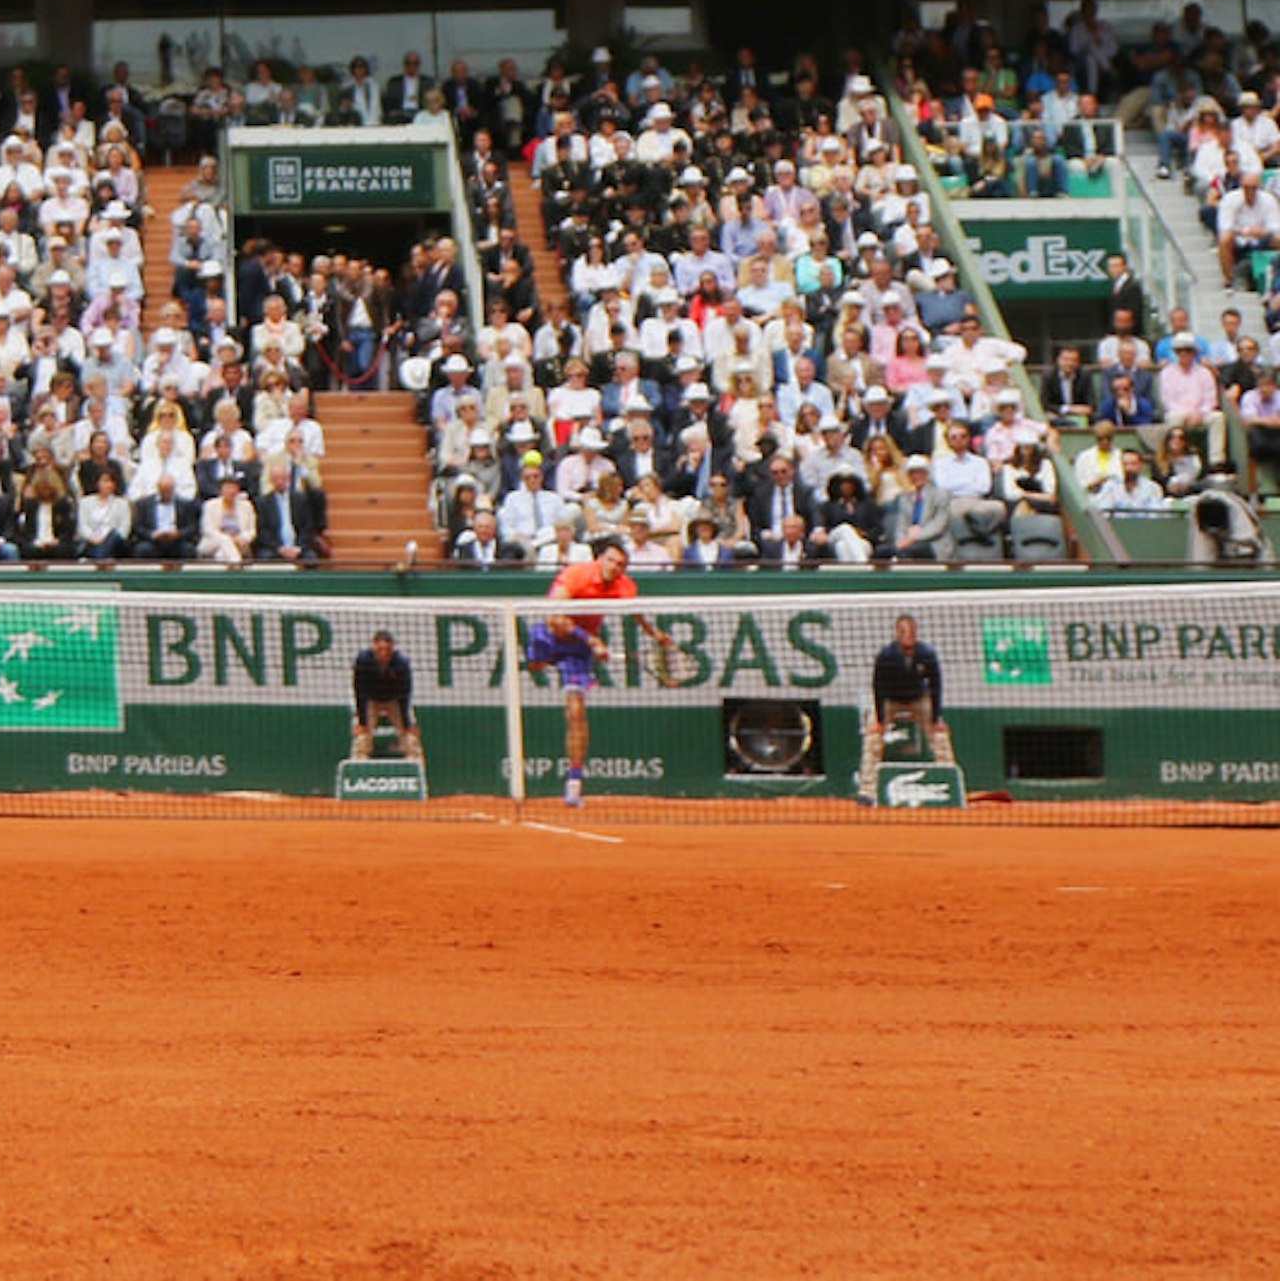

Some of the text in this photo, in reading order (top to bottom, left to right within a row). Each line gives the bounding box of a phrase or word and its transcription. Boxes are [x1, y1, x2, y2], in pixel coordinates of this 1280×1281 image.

[146, 612, 334, 688] BNP
[1066, 622, 1161, 662] BNP
[67, 753, 227, 776] BNP PARIBAS
[1160, 761, 1216, 783] BNP
[343, 776, 419, 793] LACOSTE
